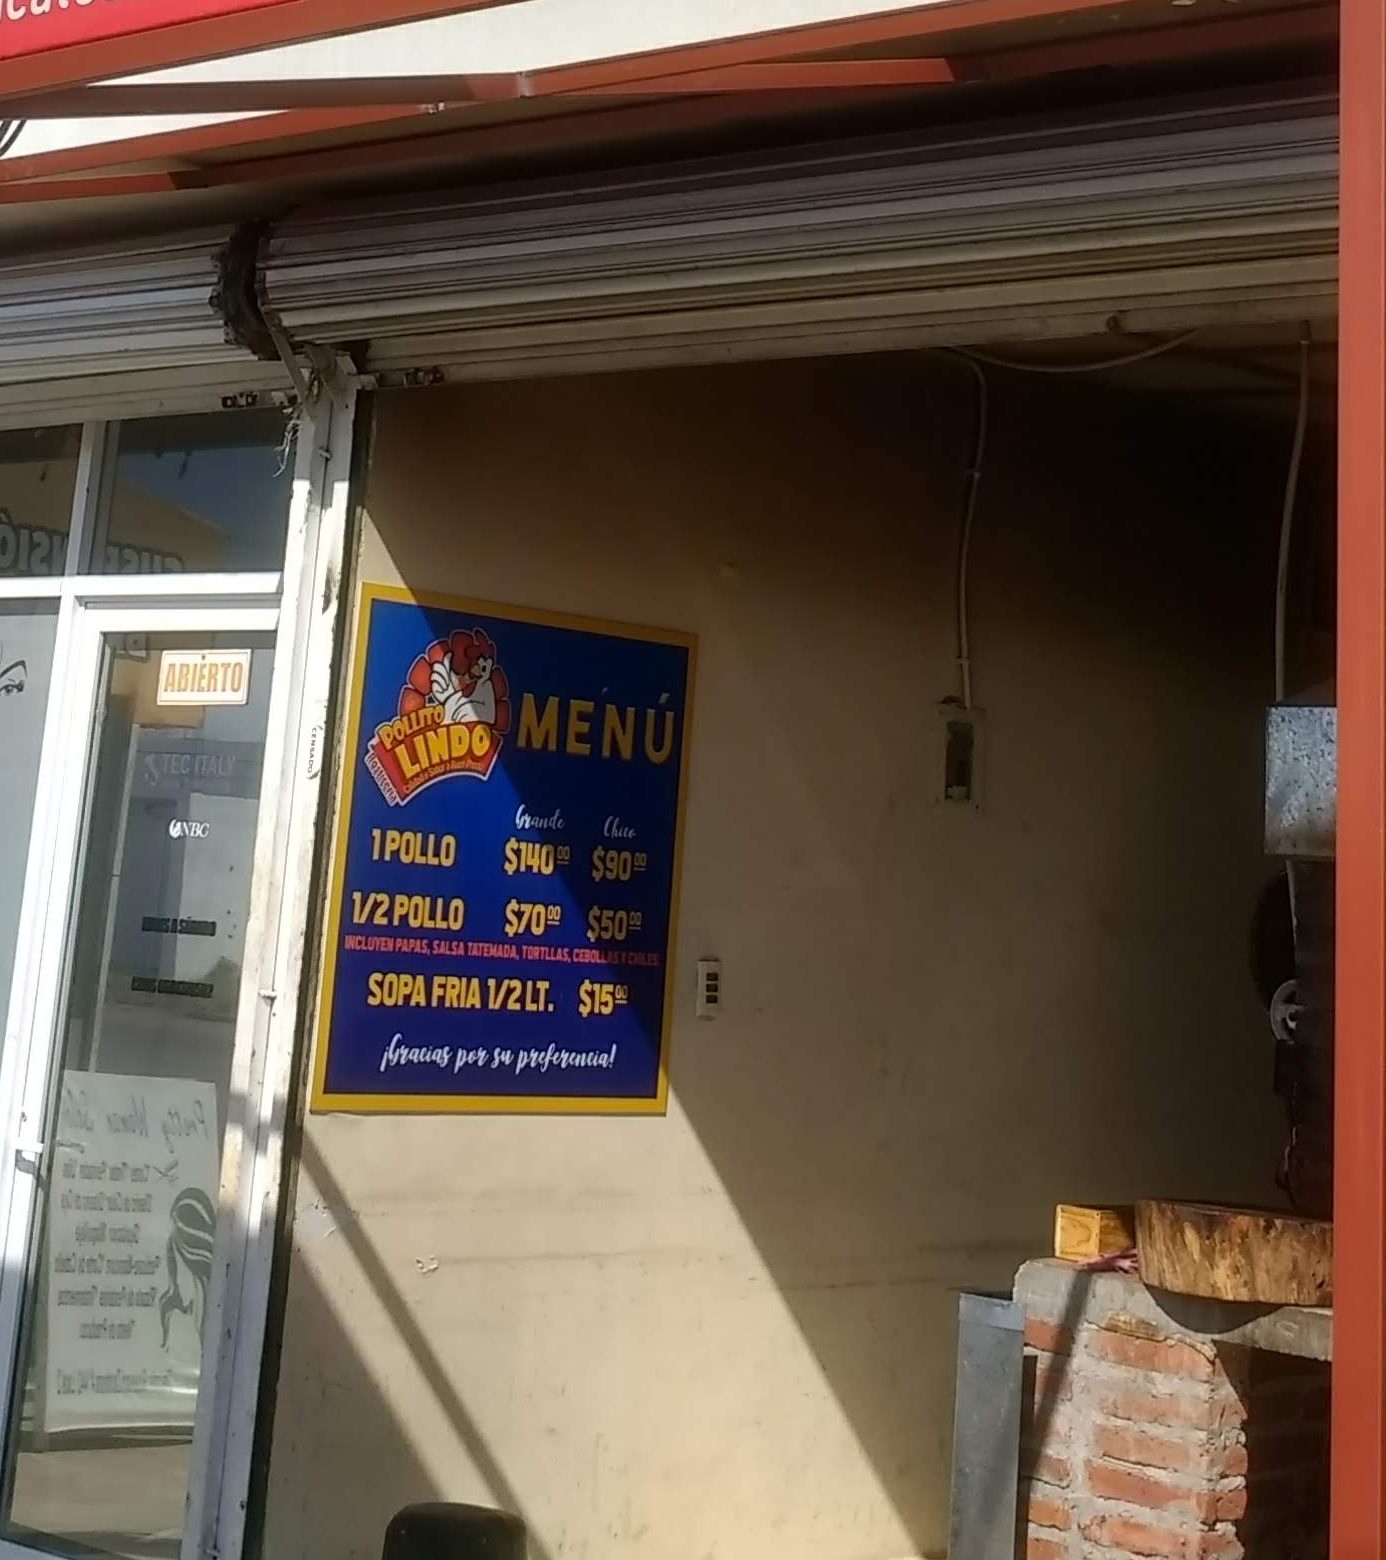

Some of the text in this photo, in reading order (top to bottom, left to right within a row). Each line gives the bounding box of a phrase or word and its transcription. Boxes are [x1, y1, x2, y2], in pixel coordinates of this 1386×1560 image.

[163, 662, 244, 693] ABIERTO
[377, 704, 445, 751] POLLITO
[517, 692, 675, 764] MENÚ
[394, 723, 492, 779] LINDO
[515, 804, 637, 839] Grande Chico
[371, 828, 382, 861] 1
[384, 829, 457, 868] POLLO
[352, 891, 390, 926] 1/2
[392, 893, 465, 931] POLLO
[432, 939, 464, 956] SALSA
[572, 948, 619, 965] CEBOLLAS
[367, 972, 427, 1007] SOPA
[431, 975, 482, 1010] FRIA
[487, 977, 522, 1011] 1/2
[453, 1047, 489, 1075] por
[490, 1043, 514, 1070] su
[515, 1042, 618, 1076] preferencia!
